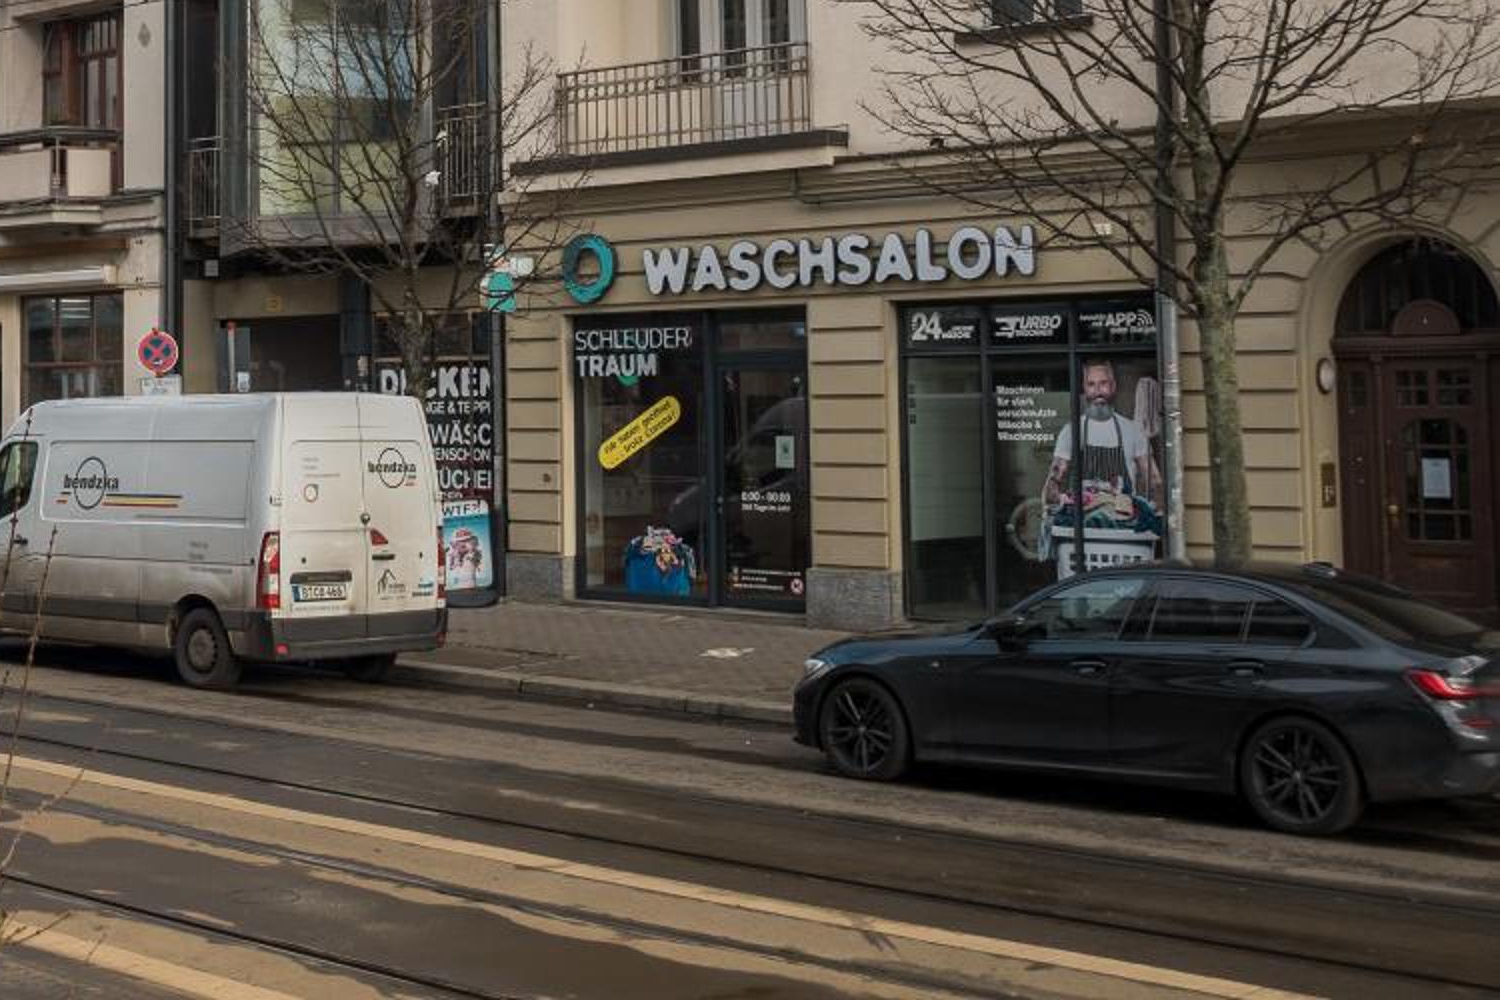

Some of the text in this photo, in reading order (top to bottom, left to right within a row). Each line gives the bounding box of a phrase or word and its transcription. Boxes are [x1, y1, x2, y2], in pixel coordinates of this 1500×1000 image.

[642, 225, 1035, 295] WASCHSALON
[911, 311, 942, 341] 24
[1106, 312, 1137, 327] APP
[575, 327, 691, 351] SCHLEUDER
[575, 353, 659, 378] TRAUM
[63, 473, 119, 490] bendzka
